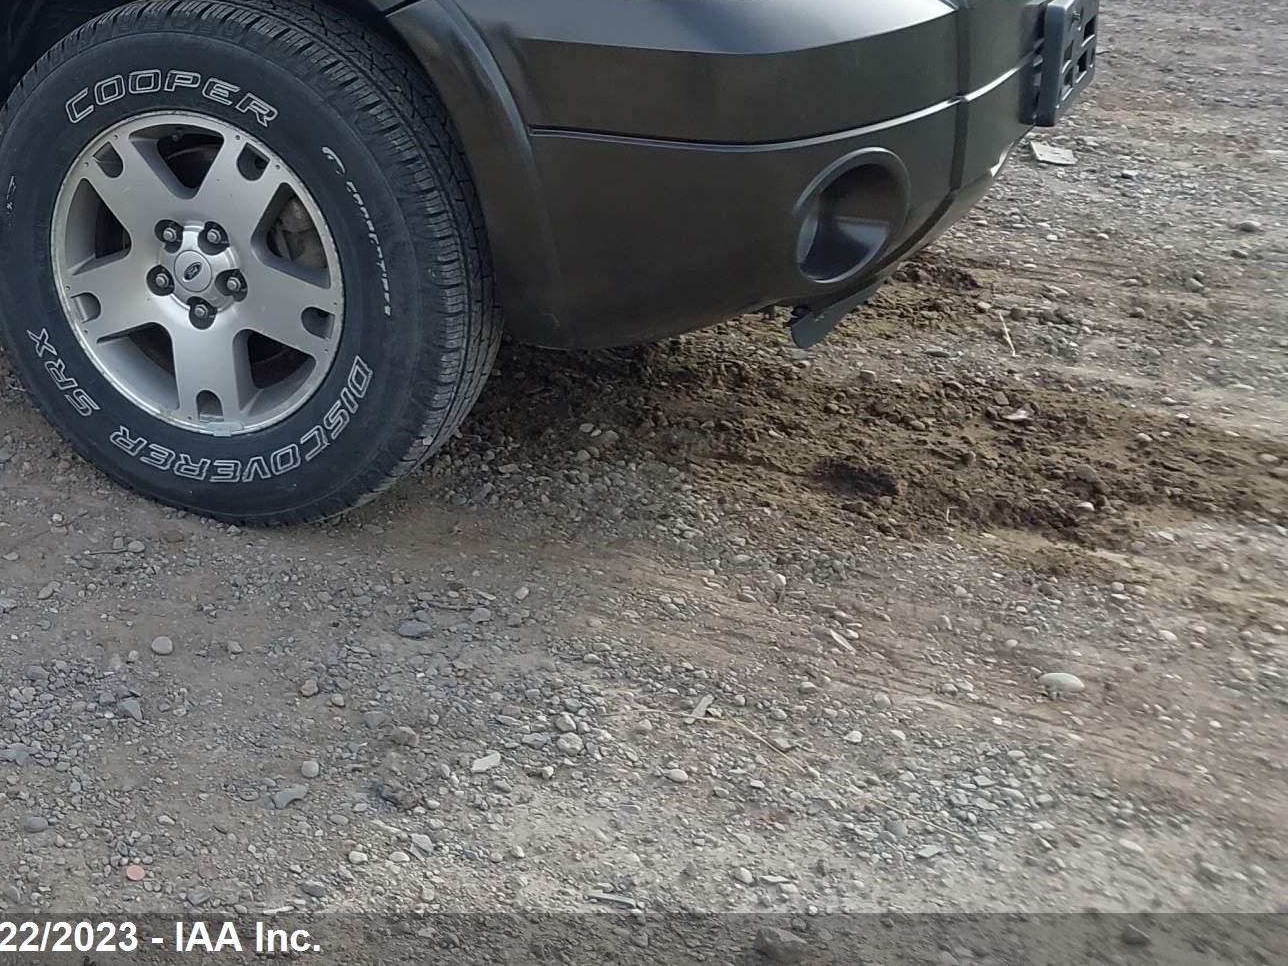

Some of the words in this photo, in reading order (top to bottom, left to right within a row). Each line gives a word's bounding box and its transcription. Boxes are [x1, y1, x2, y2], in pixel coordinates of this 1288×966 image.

[65, 69, 279, 128] COOPER
[26, 327, 101, 416] SRX
[109, 355, 373, 484] DISCOVERER
